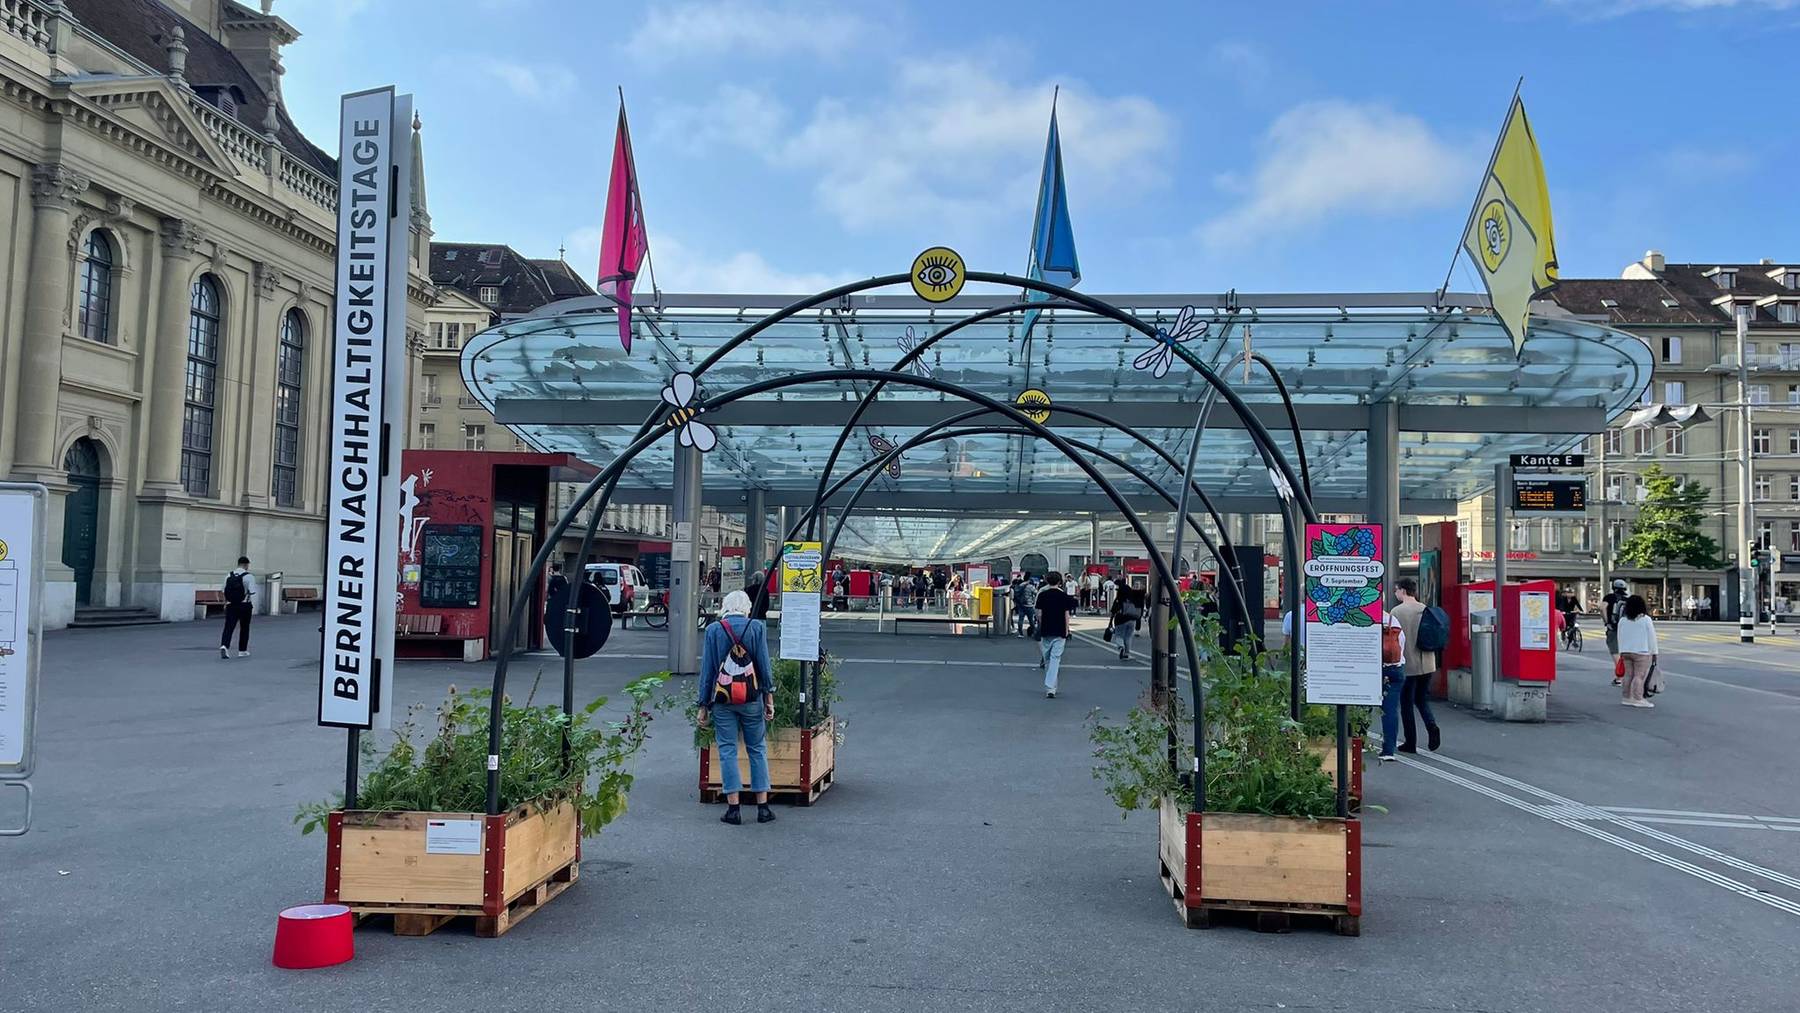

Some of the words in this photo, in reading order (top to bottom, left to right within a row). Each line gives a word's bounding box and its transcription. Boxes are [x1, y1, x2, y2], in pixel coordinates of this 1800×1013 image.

[340, 119, 380, 544] NACHHALTIGKEITSTAGE
[1520, 455, 1560, 465] Kante
[1565, 455, 1572, 465] E
[1309, 563, 1379, 573] ERÖFFNUNGSFEST
[1331, 577, 1364, 585] September
[333, 554, 365, 701] BERNER
